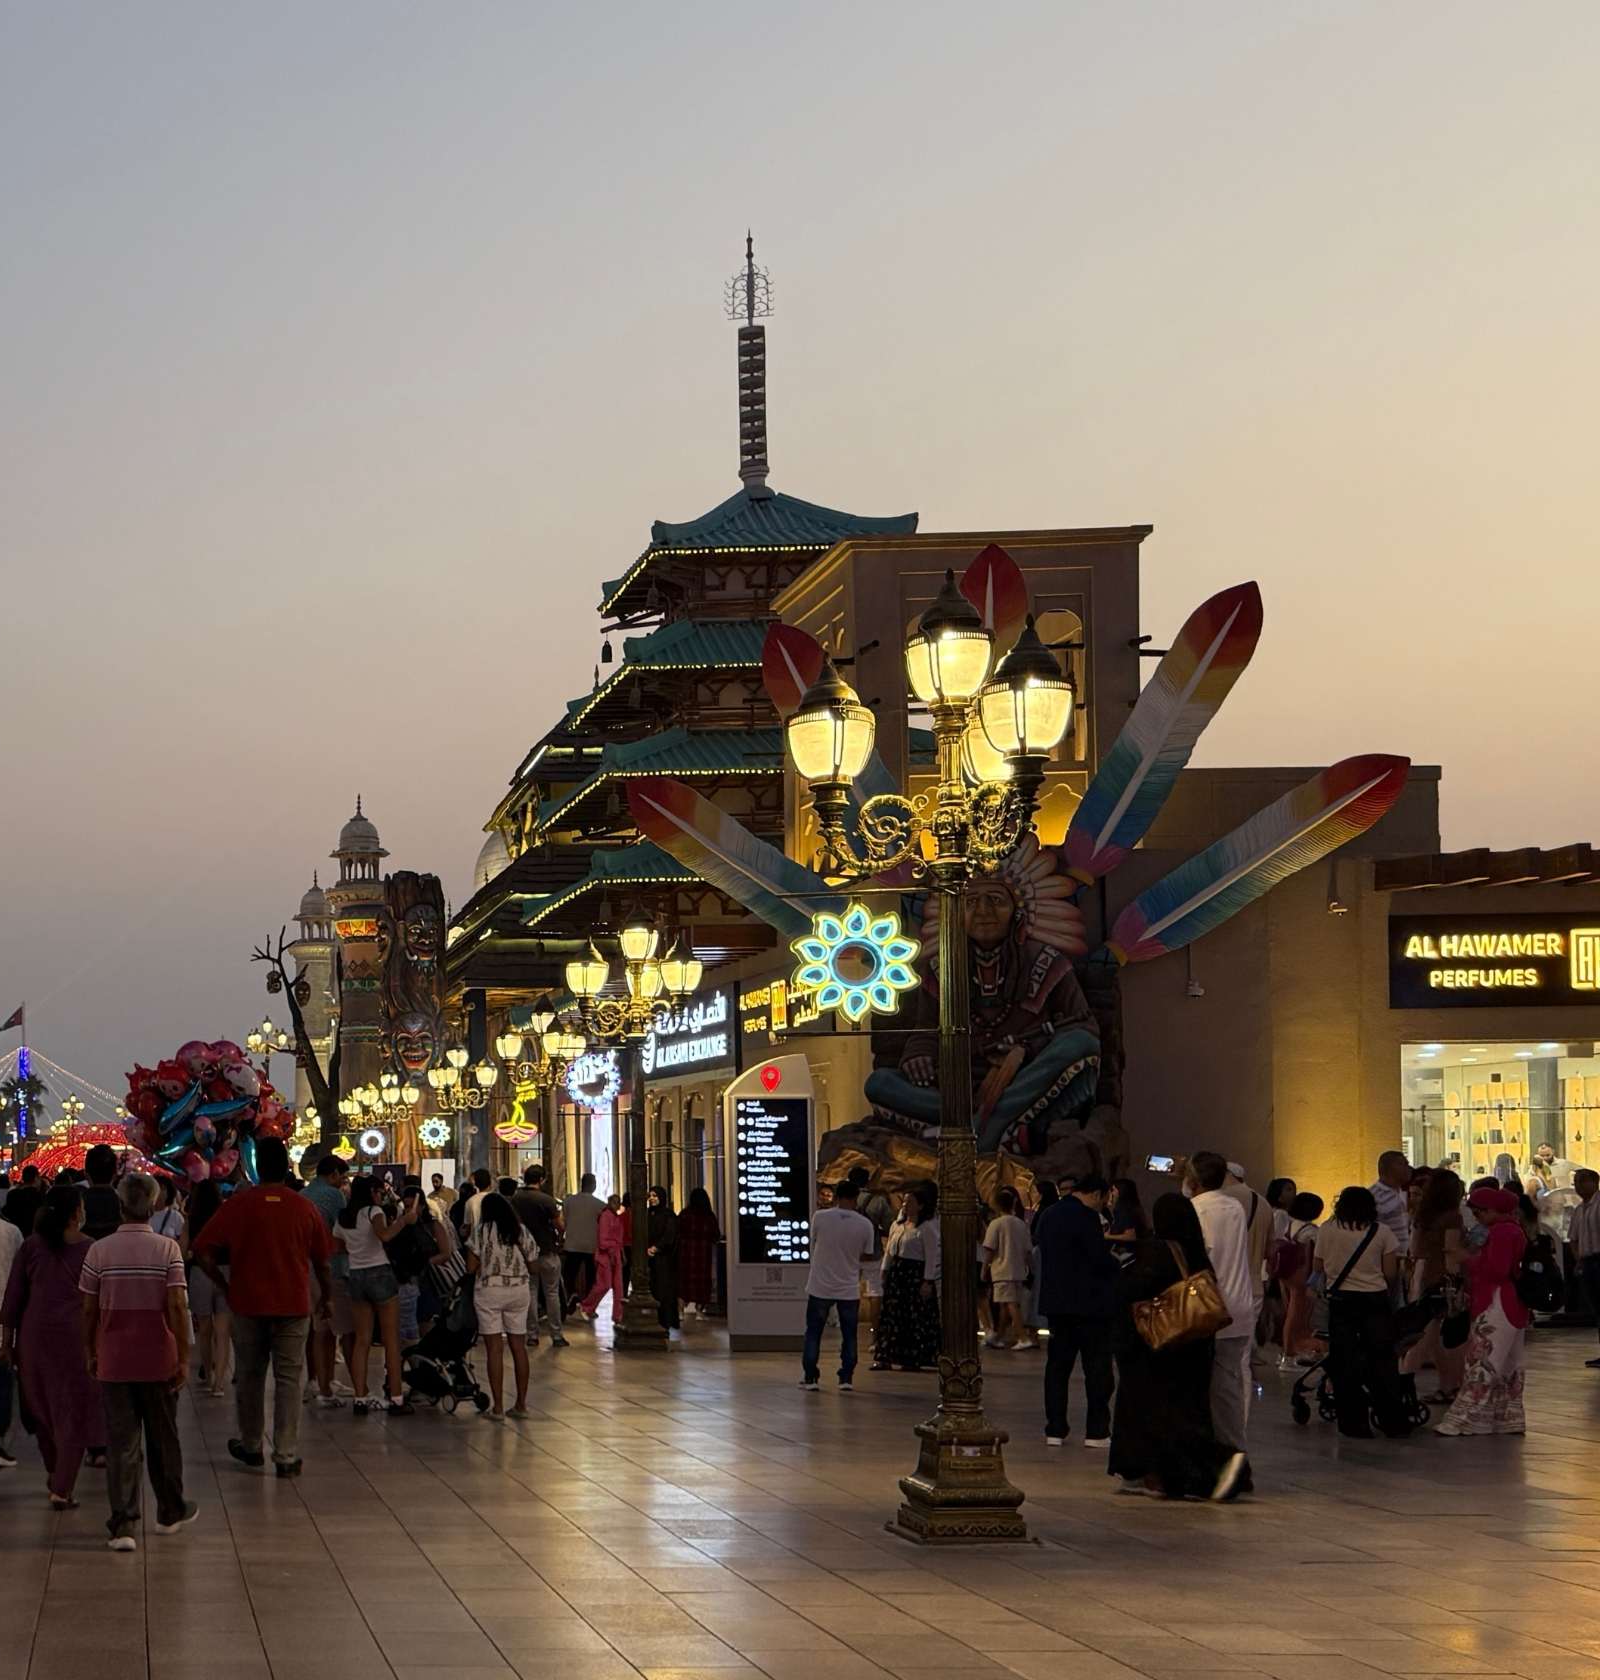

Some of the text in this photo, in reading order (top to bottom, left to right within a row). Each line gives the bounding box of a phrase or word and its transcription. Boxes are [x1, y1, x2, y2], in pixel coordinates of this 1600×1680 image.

[1406, 933, 1563, 959] AL HAWAMER
[1429, 968, 1538, 988] PERFUMES
